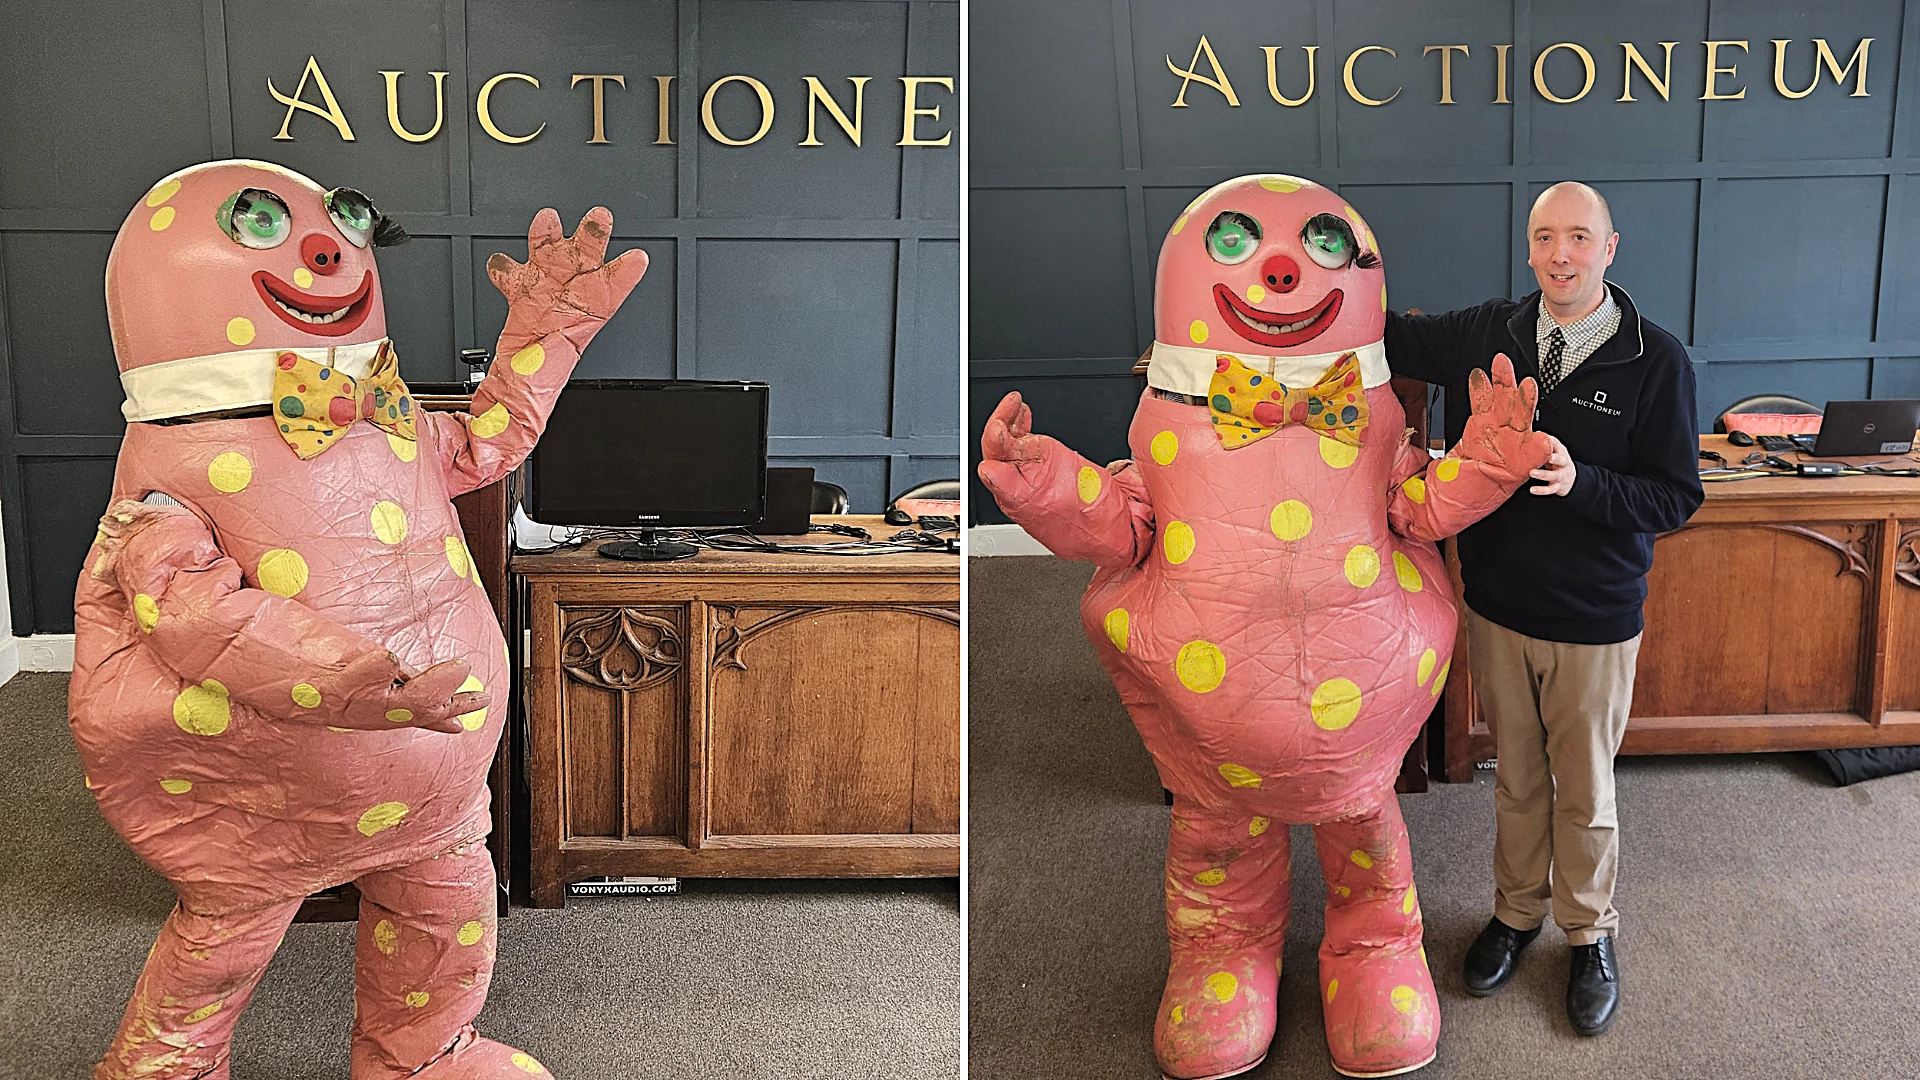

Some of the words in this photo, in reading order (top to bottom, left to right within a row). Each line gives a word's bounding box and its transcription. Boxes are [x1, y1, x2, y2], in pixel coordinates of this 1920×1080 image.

[267, 55, 955, 147] AUCTIONE
[1166, 34, 1876, 108] AUCTIONEUM
[571, 885, 677, 894] VONYXAUDIO.COM
